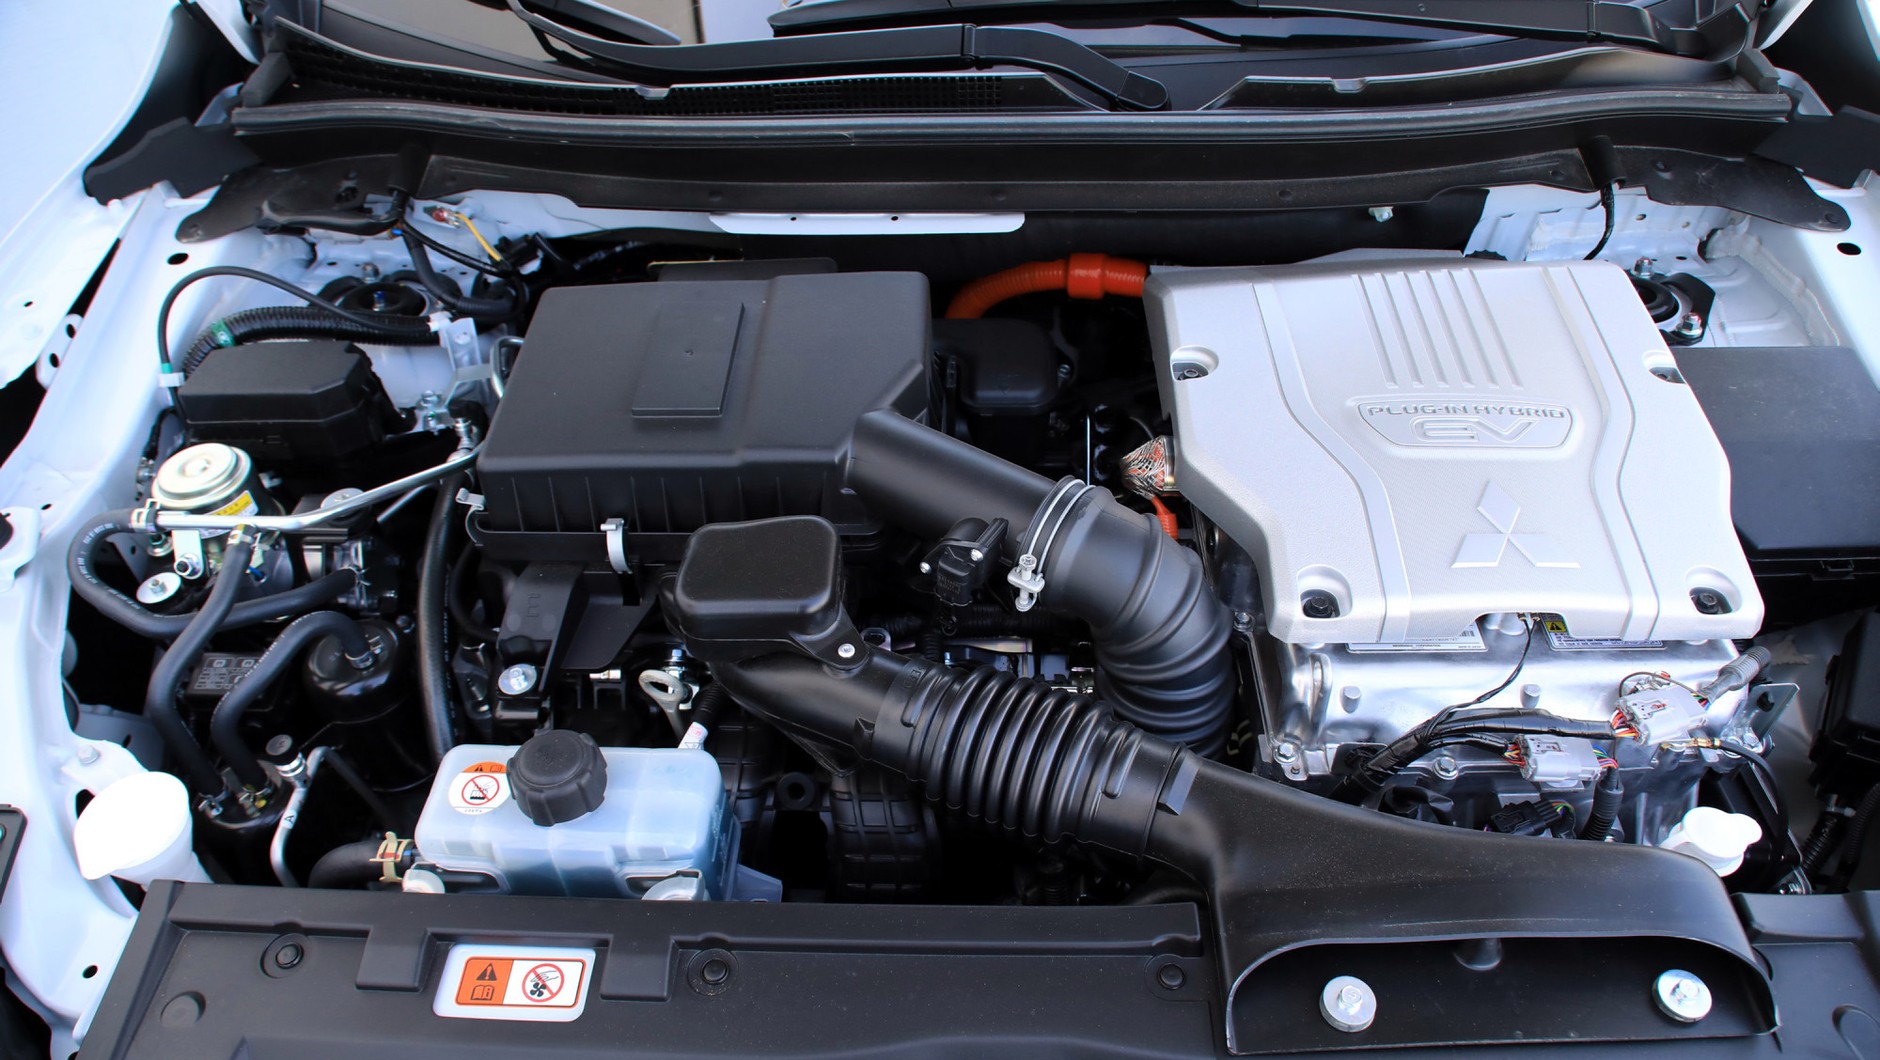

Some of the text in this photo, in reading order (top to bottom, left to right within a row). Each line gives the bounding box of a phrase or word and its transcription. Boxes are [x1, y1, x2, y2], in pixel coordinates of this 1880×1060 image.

[1368, 404, 1566, 419] PLUG-IN HYBRID
[1411, 416, 1539, 443] EV
